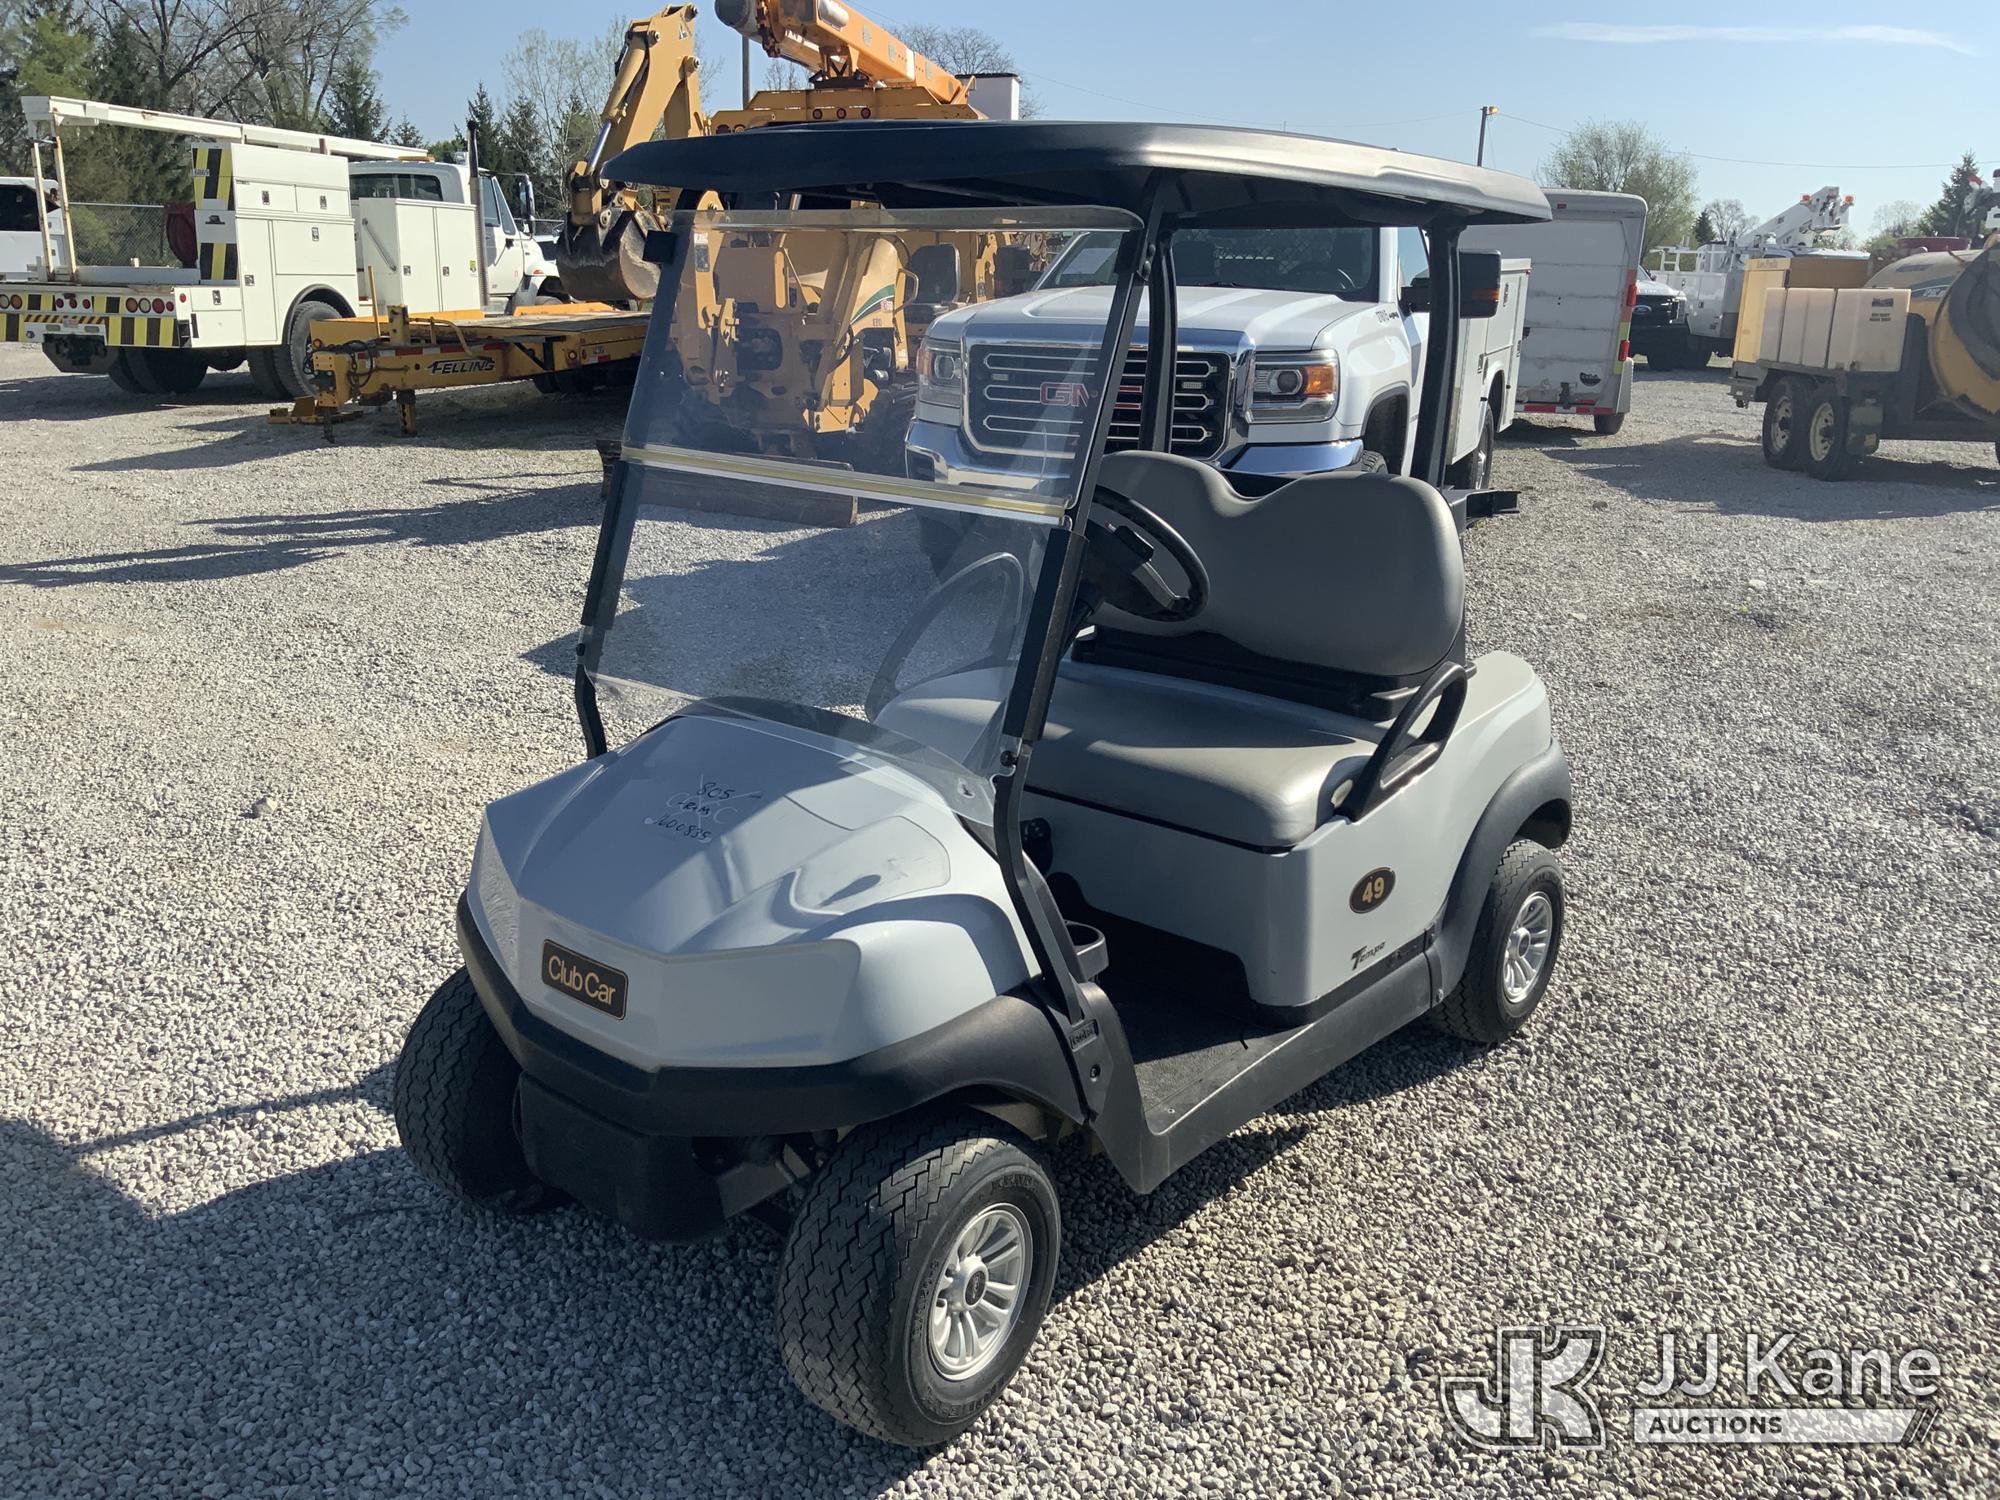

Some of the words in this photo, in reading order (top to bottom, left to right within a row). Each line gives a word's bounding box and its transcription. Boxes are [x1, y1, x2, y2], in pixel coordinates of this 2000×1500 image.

[428, 357, 496, 374] FELLING
[1362, 877, 1385, 903] 49
[548, 955, 583, 992] Club
[584, 972, 616, 1006] Car
